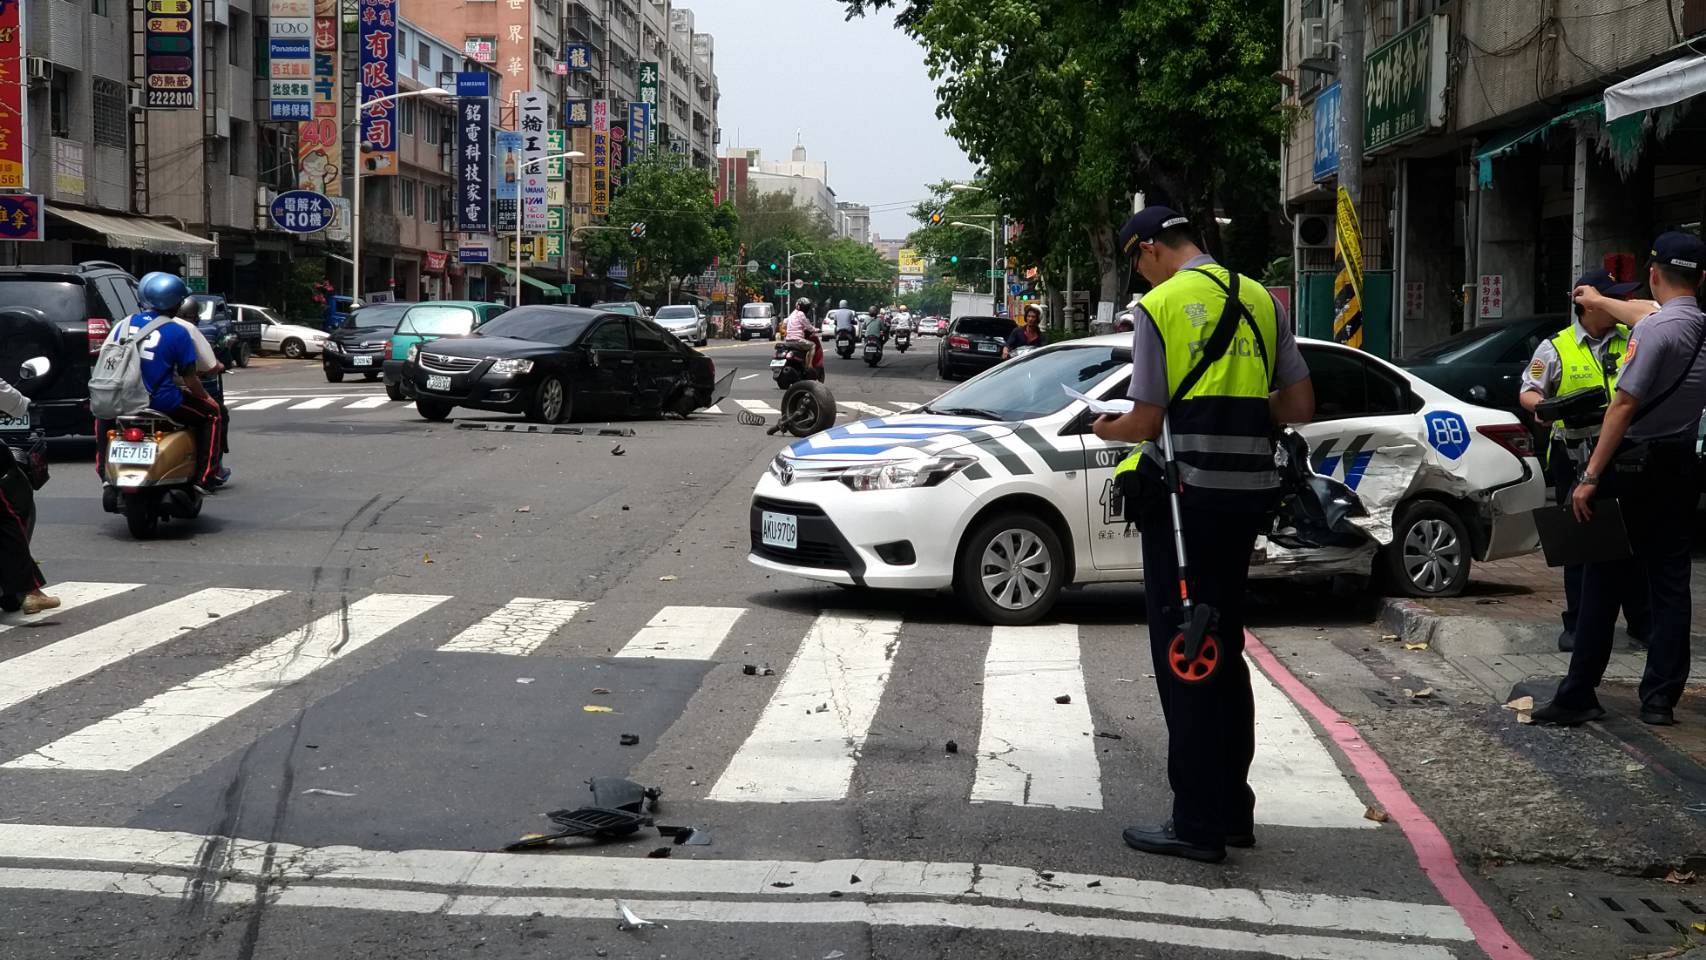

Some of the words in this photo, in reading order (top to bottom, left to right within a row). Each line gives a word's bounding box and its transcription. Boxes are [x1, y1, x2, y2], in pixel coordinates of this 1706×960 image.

[272, 22, 308, 34] TOYO
[271, 44, 310, 53] Panasonic
[362, 29, 395, 149] 有限公司
[149, 91, 193, 106] 2222810
[272, 103, 310, 118] 維修保養
[464, 103, 483, 223] 銘電科技家電
[284, 197, 321, 212] 電解水
[1188, 335, 1263, 361] PICE
[110, 446, 153, 460] MTE-7151
